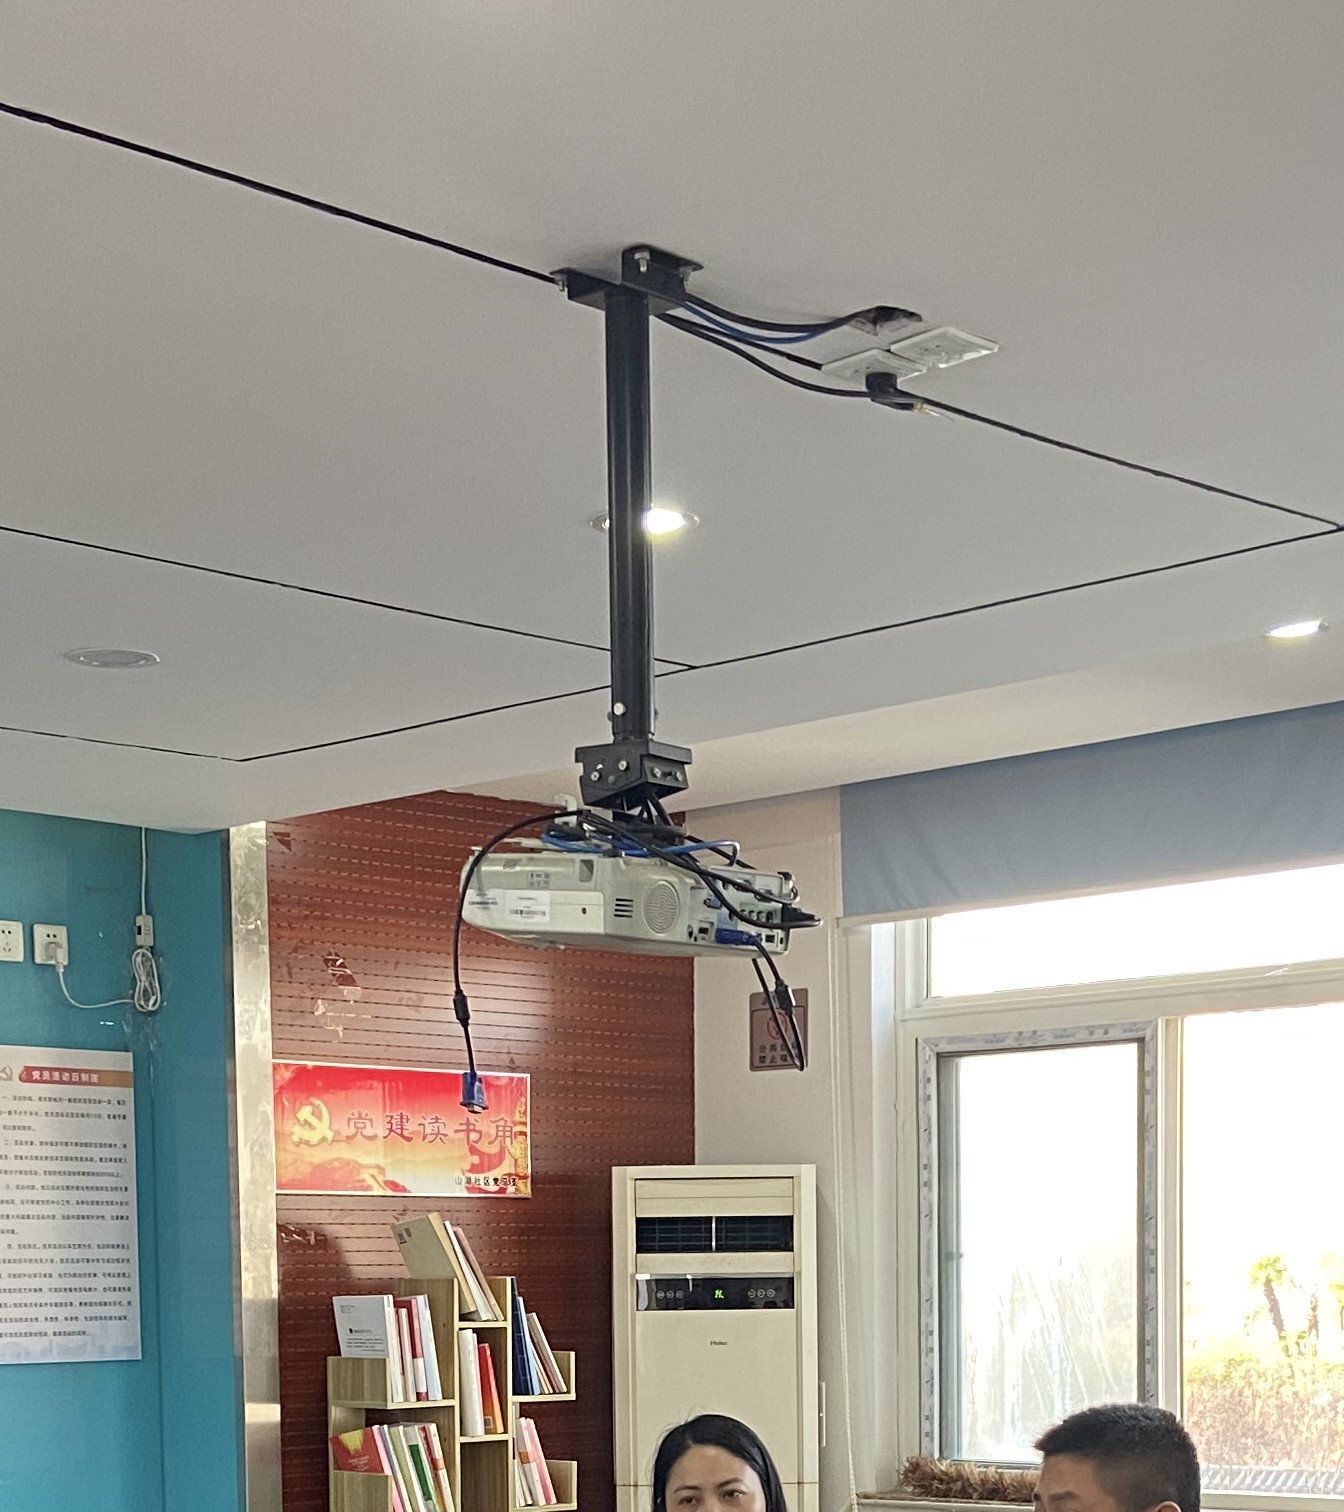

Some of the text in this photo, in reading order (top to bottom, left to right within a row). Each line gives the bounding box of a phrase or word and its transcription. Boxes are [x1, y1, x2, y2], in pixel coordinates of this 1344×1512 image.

[344, 1111, 517, 1147] 党建读书角
